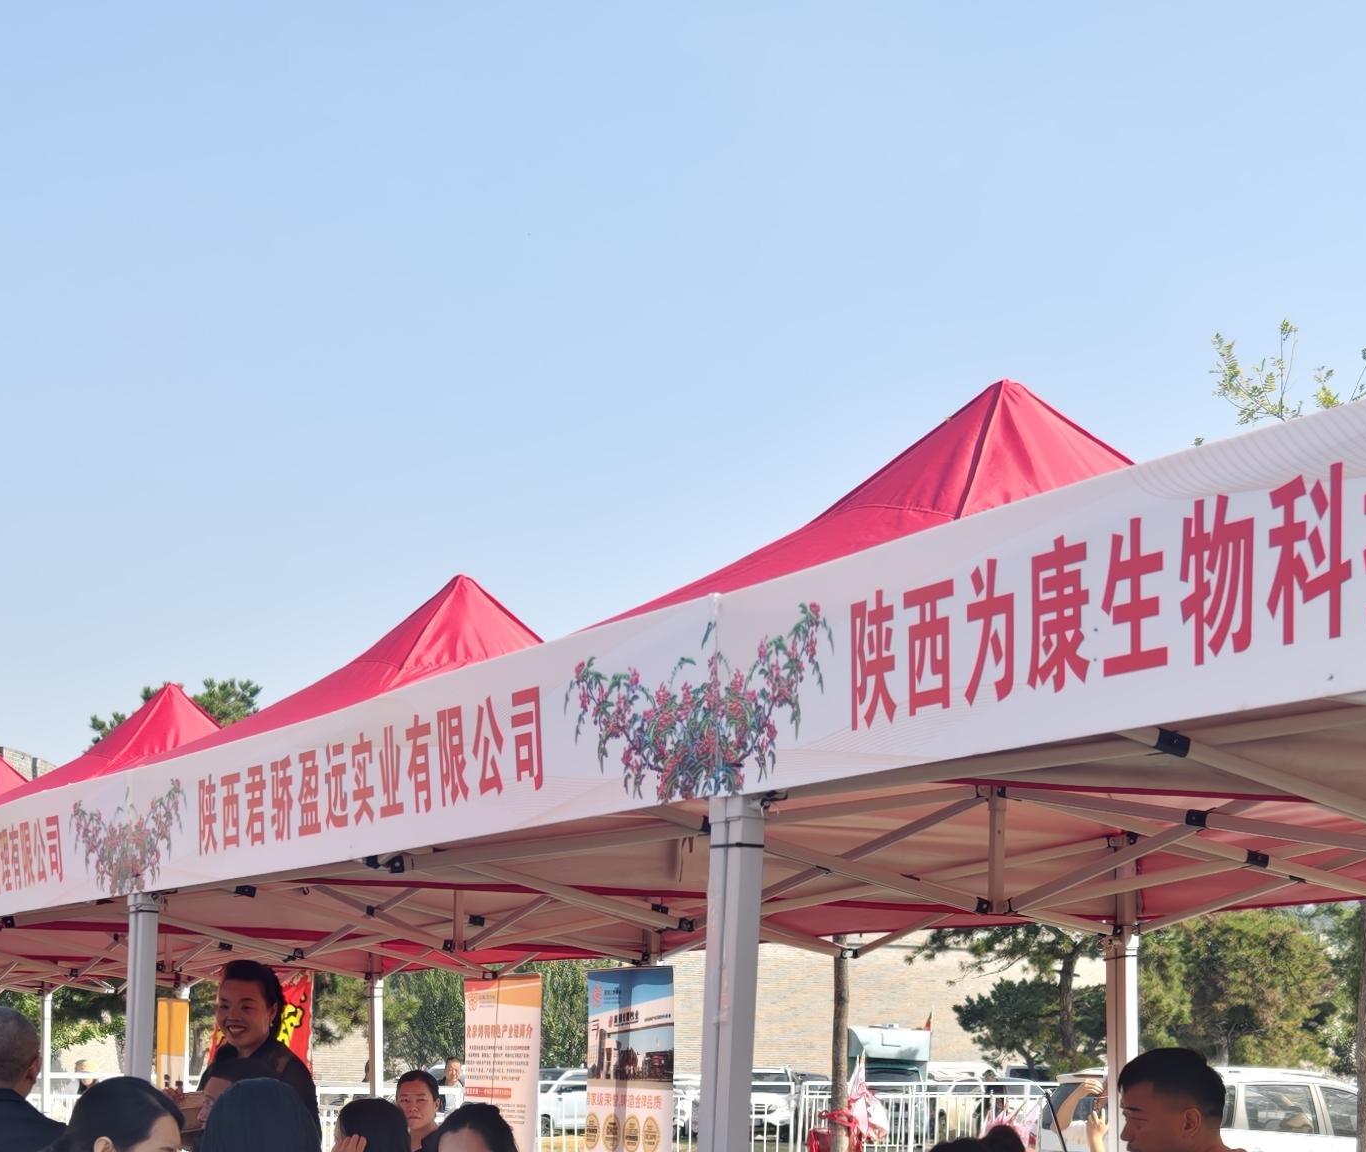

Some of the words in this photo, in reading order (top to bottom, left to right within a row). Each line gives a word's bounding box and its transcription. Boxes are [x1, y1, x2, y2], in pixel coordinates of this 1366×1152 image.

[198, 686, 544, 857] 陕西君骄盈远实业有限公司
